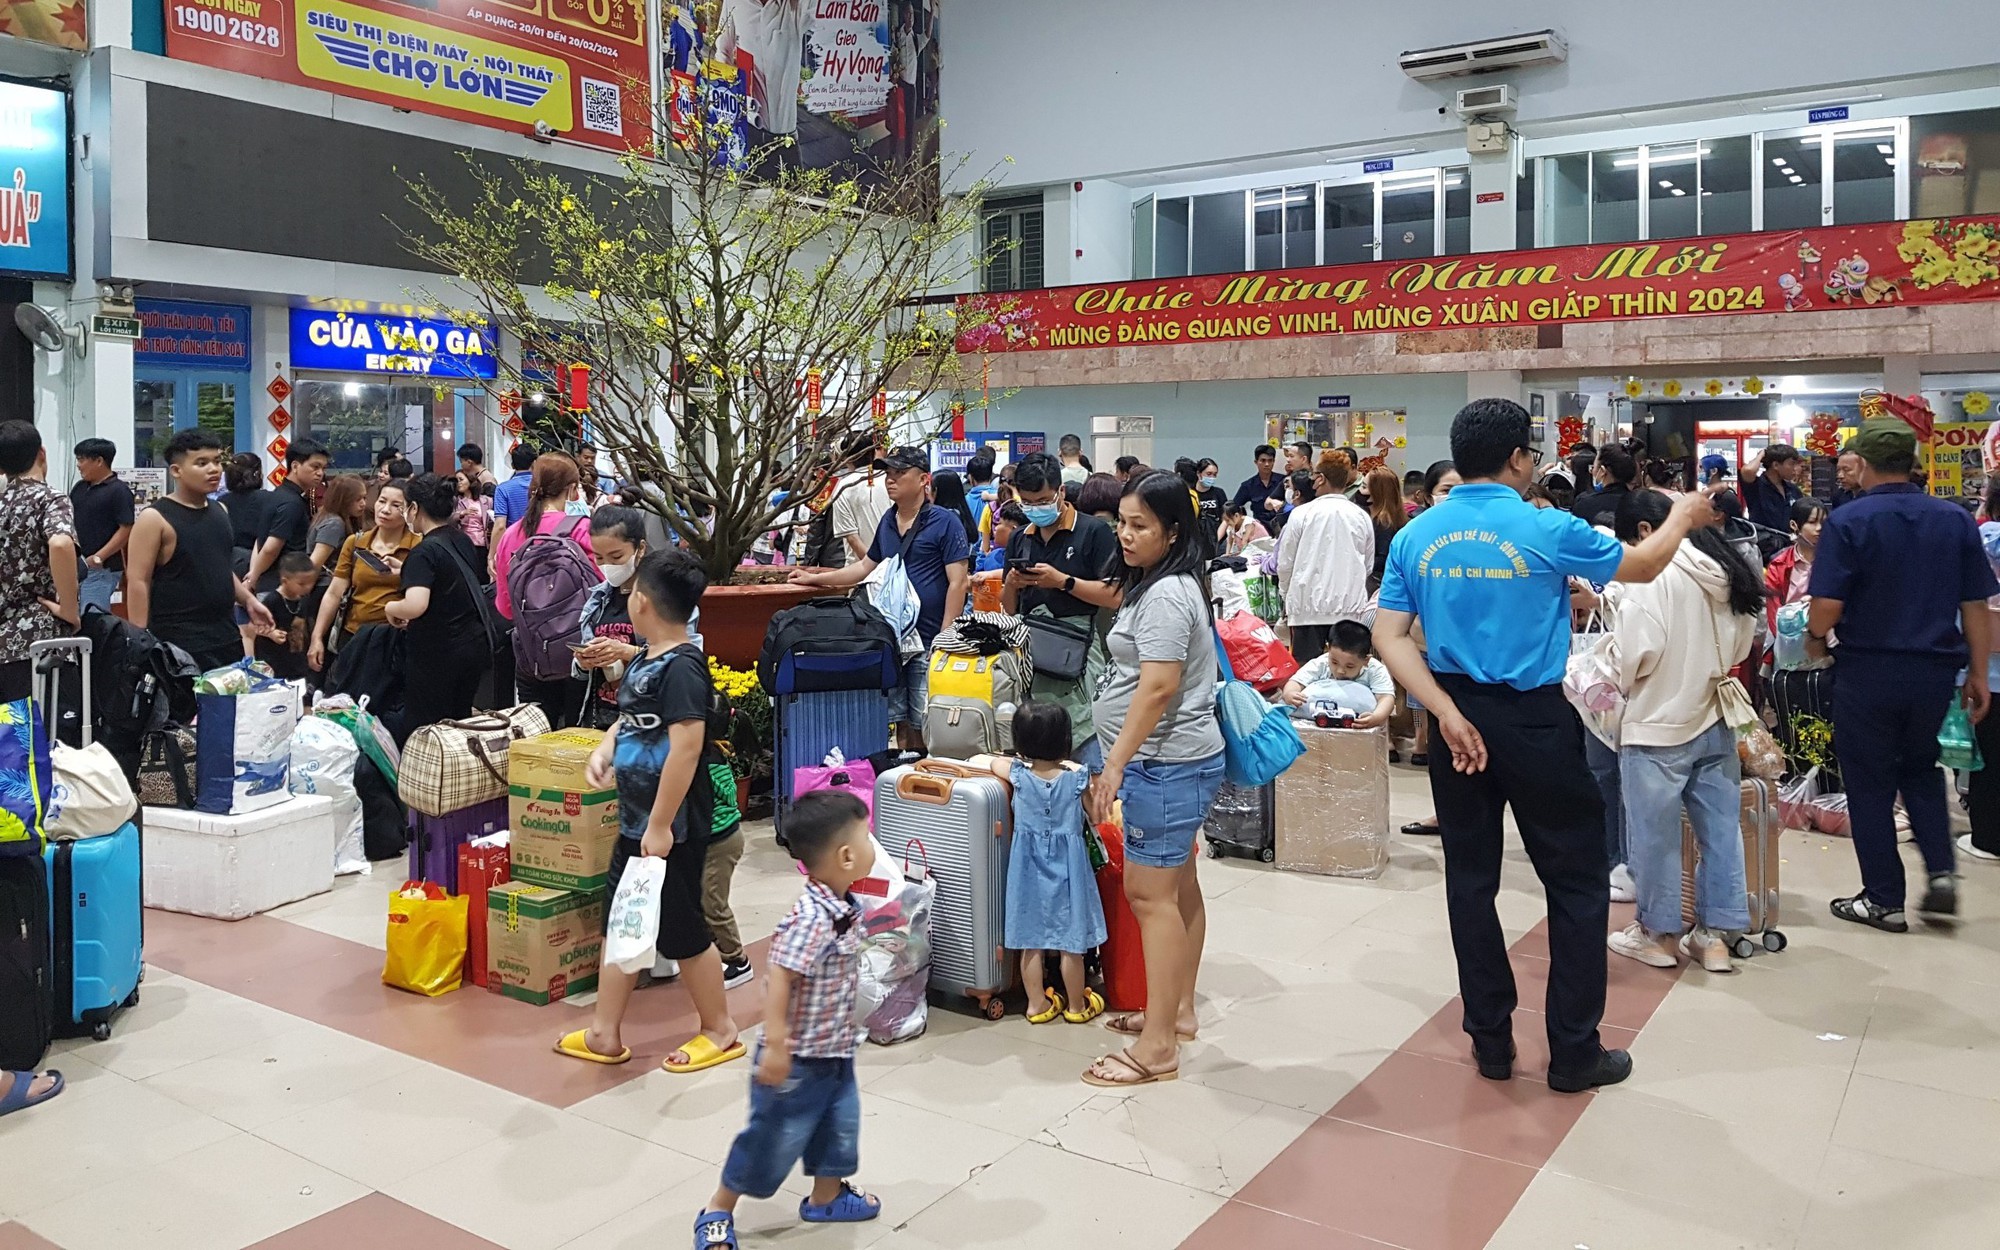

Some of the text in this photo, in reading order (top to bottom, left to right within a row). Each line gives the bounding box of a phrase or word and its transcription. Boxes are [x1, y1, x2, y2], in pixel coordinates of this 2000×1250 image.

[224, 0, 261, 18] NGAY
[174, 6, 279, 48] 1900 2628
[467, 7, 618, 57] ÁP DỤNG: 20/01 ĐẾN 20/02/2024
[835, 29, 857, 46] Gieo
[308, 12, 347, 33] SIÊU
[353, 23, 382, 44] THỊ
[388, 30, 428, 55] ĐIỆN
[434, 42, 468, 62] MÁY
[485, 56, 513, 74] NỘI
[518, 64, 553, 83] THẤT
[373, 50, 505, 100] CHỢ LỚN
[823, 48, 884, 84] Hy Vọng
[677, 98, 694, 114] OMO
[712, 90, 737, 113] OMO
[1074, 243, 1728, 316] Chúc Mừng Năm Mới
[103, 319, 129, 327] EXIT
[1050, 285, 1765, 346] MỪNG ĐẢNG QUANG VINH, MỪNG XUÂN GIÁP THÌN 2024
[309, 313, 372, 349] CỬA
[382, 321, 439, 353] VÀO
[446, 332, 483, 356] GA
[366, 354, 433, 372] ENTRY
[1926, 454, 1941, 463] BNH
[1201, 500, 1217, 509] OSS
[1435, 535, 1449, 548] CÁC
[1449, 531, 1463, 542] KHU
[1431, 565, 1512, 579] TP. HỒ CHÍ MINH
[609, 622, 633, 634] LOTS
